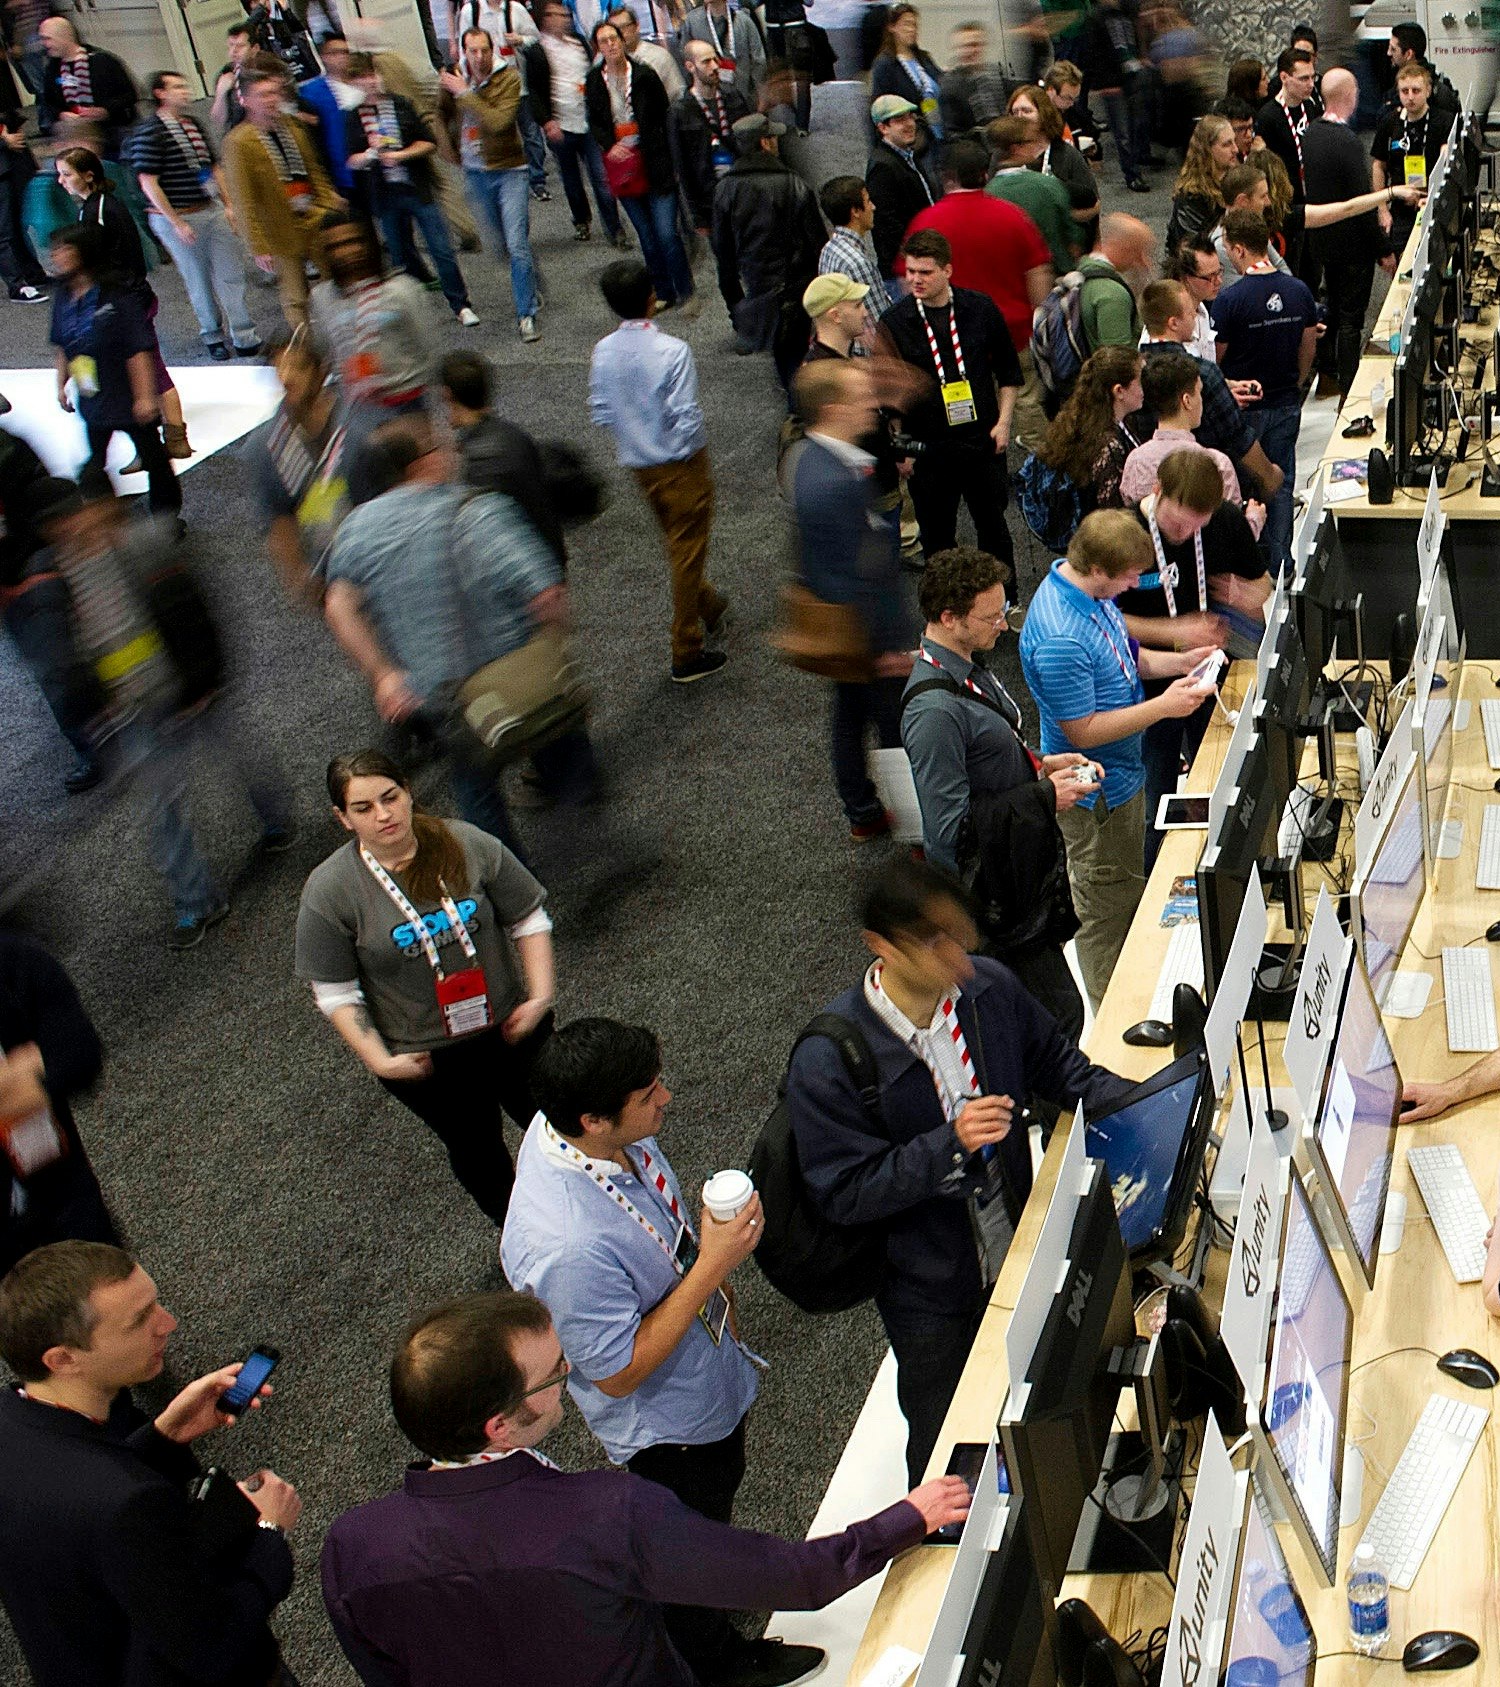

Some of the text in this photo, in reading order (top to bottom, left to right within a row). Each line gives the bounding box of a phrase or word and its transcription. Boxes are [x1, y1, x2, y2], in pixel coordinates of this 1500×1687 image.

[1434, 46, 1497, 55] Fire Extinguisher
[1381, 752, 1398, 804] unity
[1312, 953, 1332, 1016] unity
[1251, 1182, 1272, 1265] unity
[1066, 1268, 1094, 1328] DELL
[1191, 1525, 1219, 1641] unity
